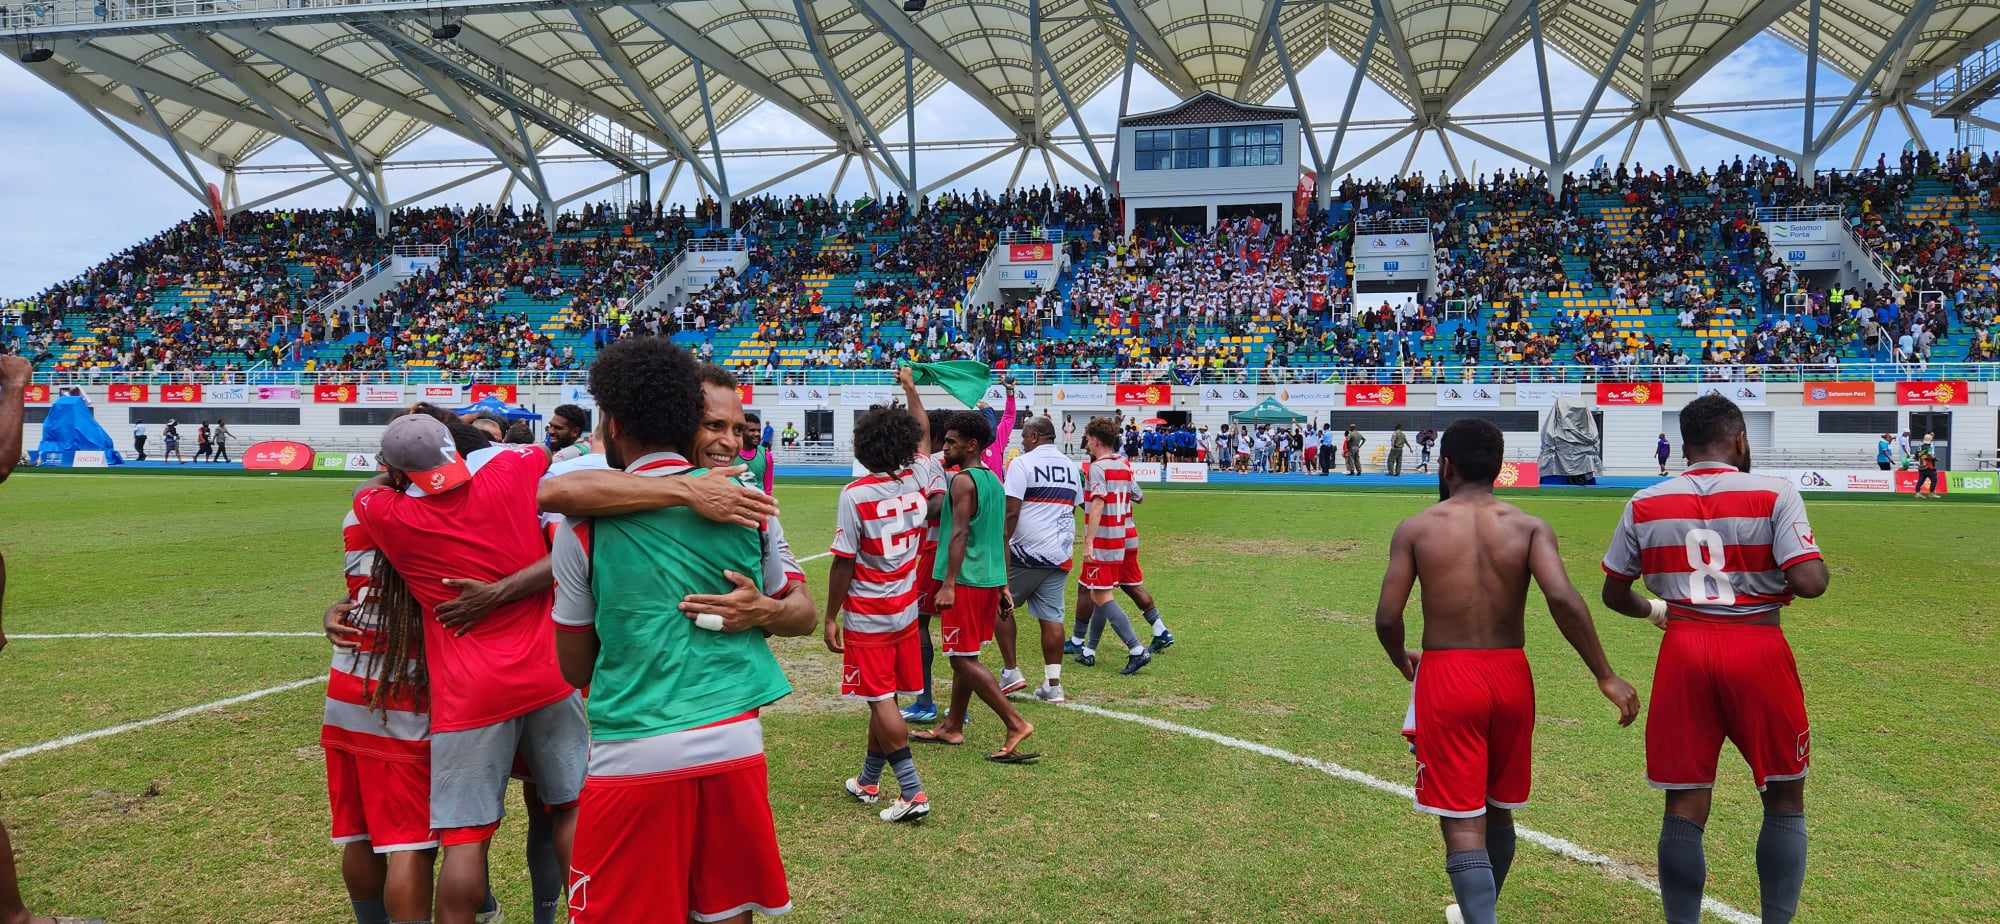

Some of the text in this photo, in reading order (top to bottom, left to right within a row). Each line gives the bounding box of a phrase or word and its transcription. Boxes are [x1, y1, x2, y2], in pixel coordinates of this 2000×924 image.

[1790, 224, 1822, 232] Solomon
[1034, 465, 1076, 485] NCL
[1966, 478, 1991, 488] BSP
[877, 491, 928, 560] 23
[1685, 528, 1735, 606] 8
